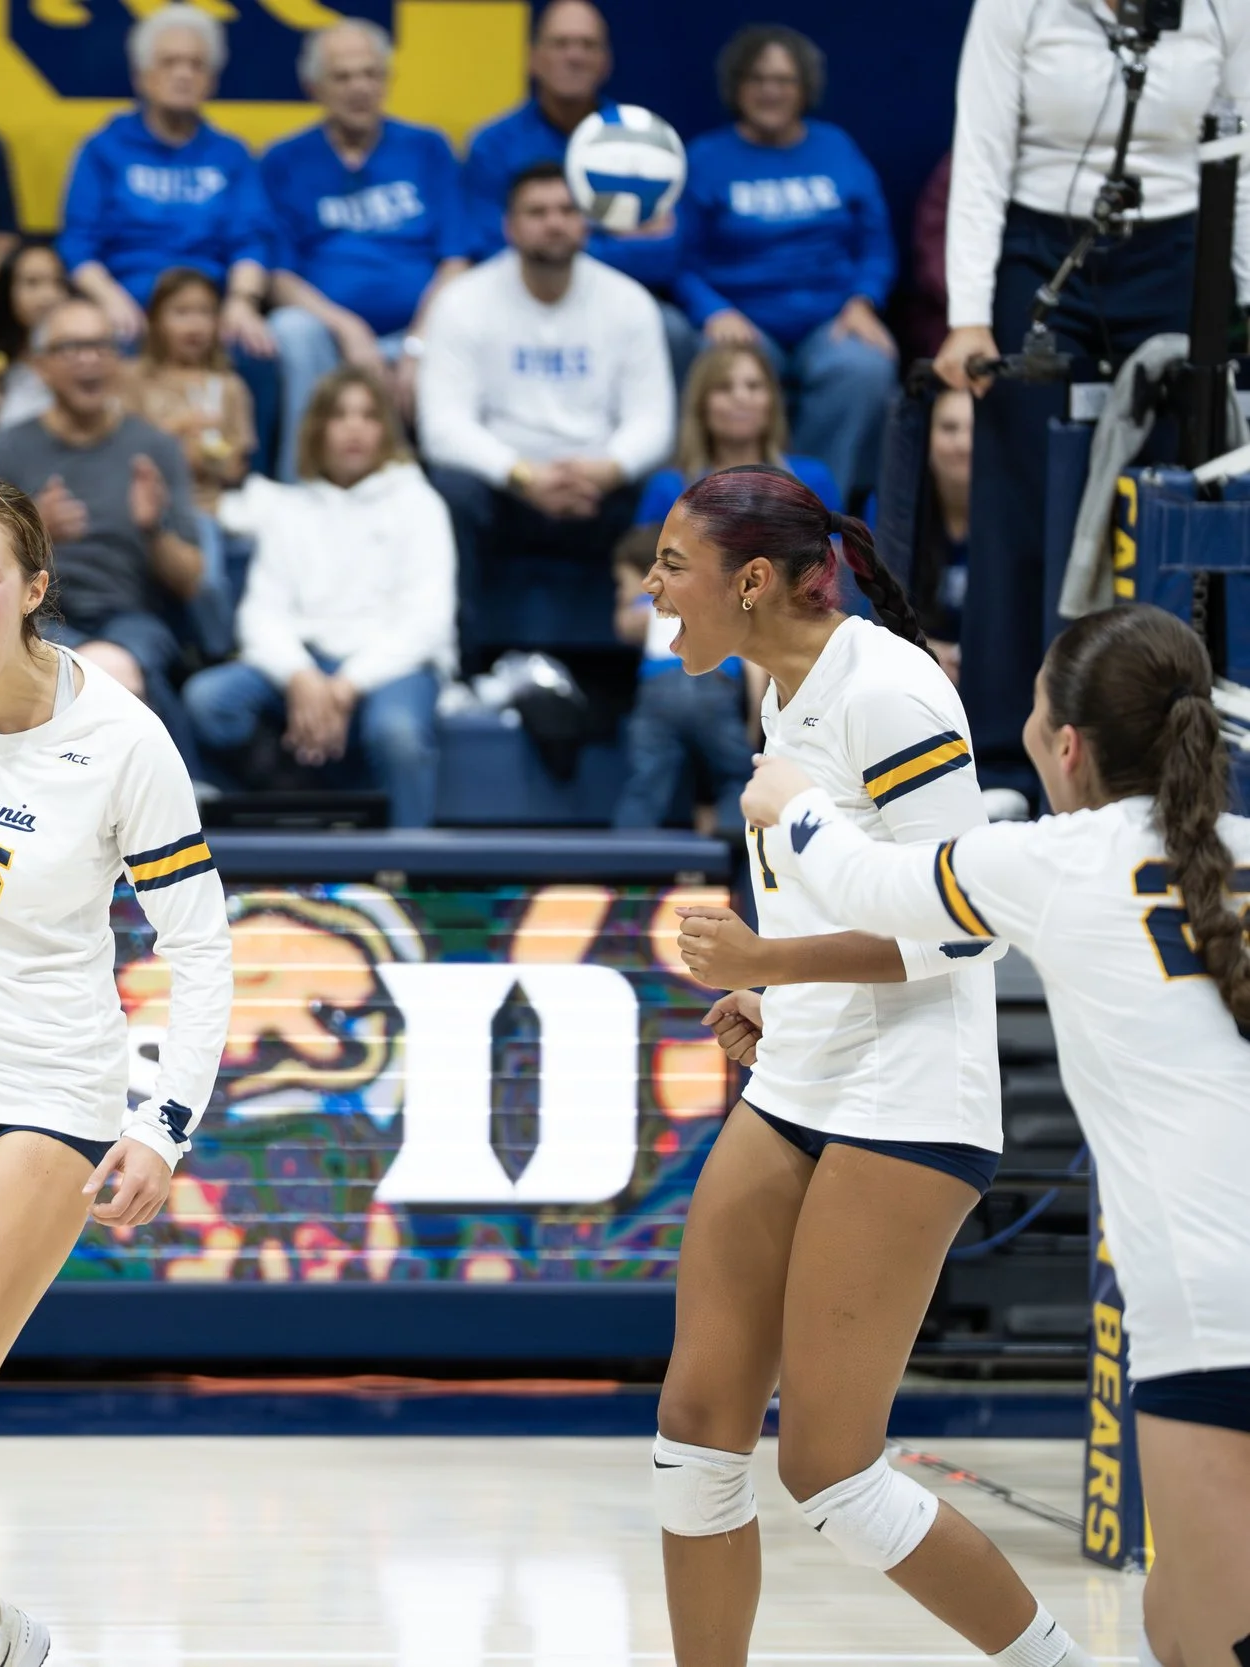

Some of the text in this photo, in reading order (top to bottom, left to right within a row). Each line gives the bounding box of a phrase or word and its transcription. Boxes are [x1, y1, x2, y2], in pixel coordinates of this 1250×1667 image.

[59, 751, 92, 766] ACC
[803, 716, 820, 728] ACC
[373, 962, 640, 1204] D
[1088, 1302, 1123, 1560] BEARS
